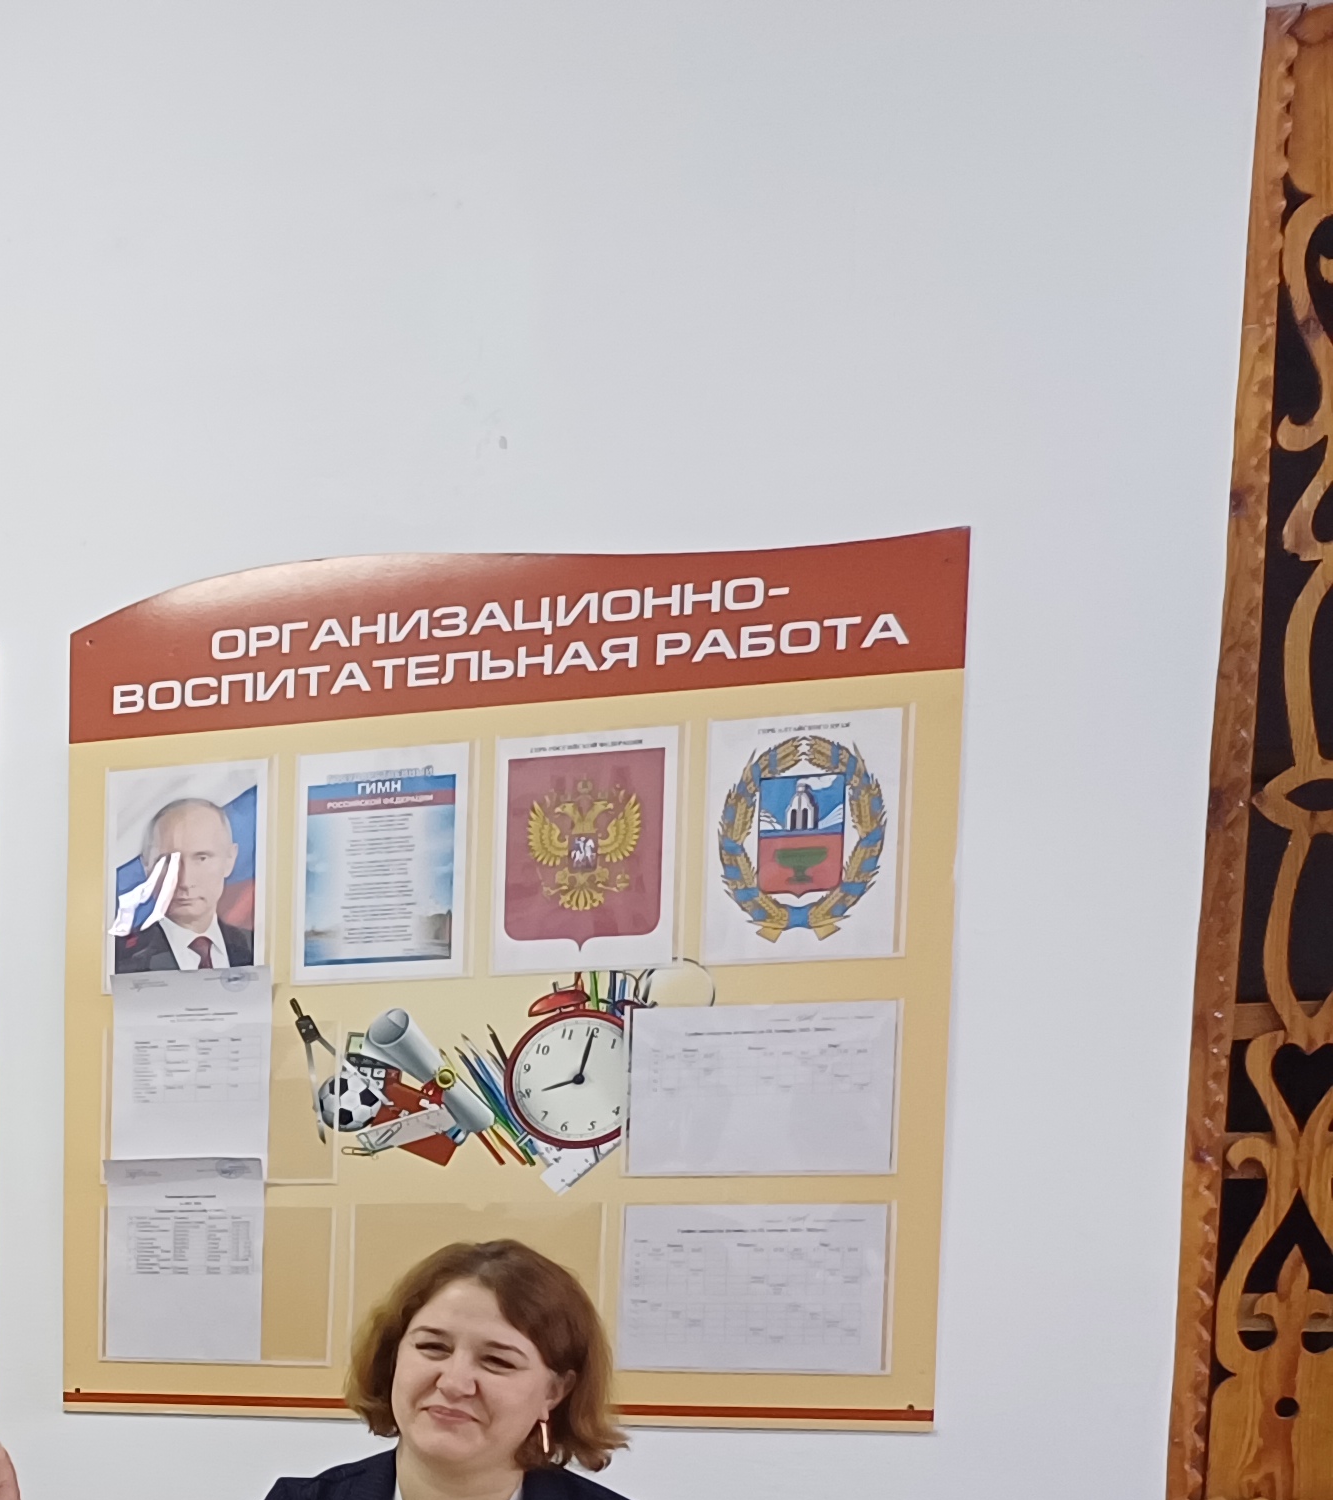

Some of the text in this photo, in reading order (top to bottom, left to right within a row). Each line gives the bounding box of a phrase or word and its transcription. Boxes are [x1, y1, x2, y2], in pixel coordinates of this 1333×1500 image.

[211, 575, 790, 662] ОРГАНИЗАЦИОННО-
[111, 612, 911, 716] ВОСПИТАТЕЛЬНАЯ РАБОТА
[357, 779, 402, 795] ГИМН
[561, 1028, 574, 1040] 11
[535, 1043, 550, 1055] 10
[523, 1063, 531, 1073] 9
[560, 1121, 570, 1132] 6
